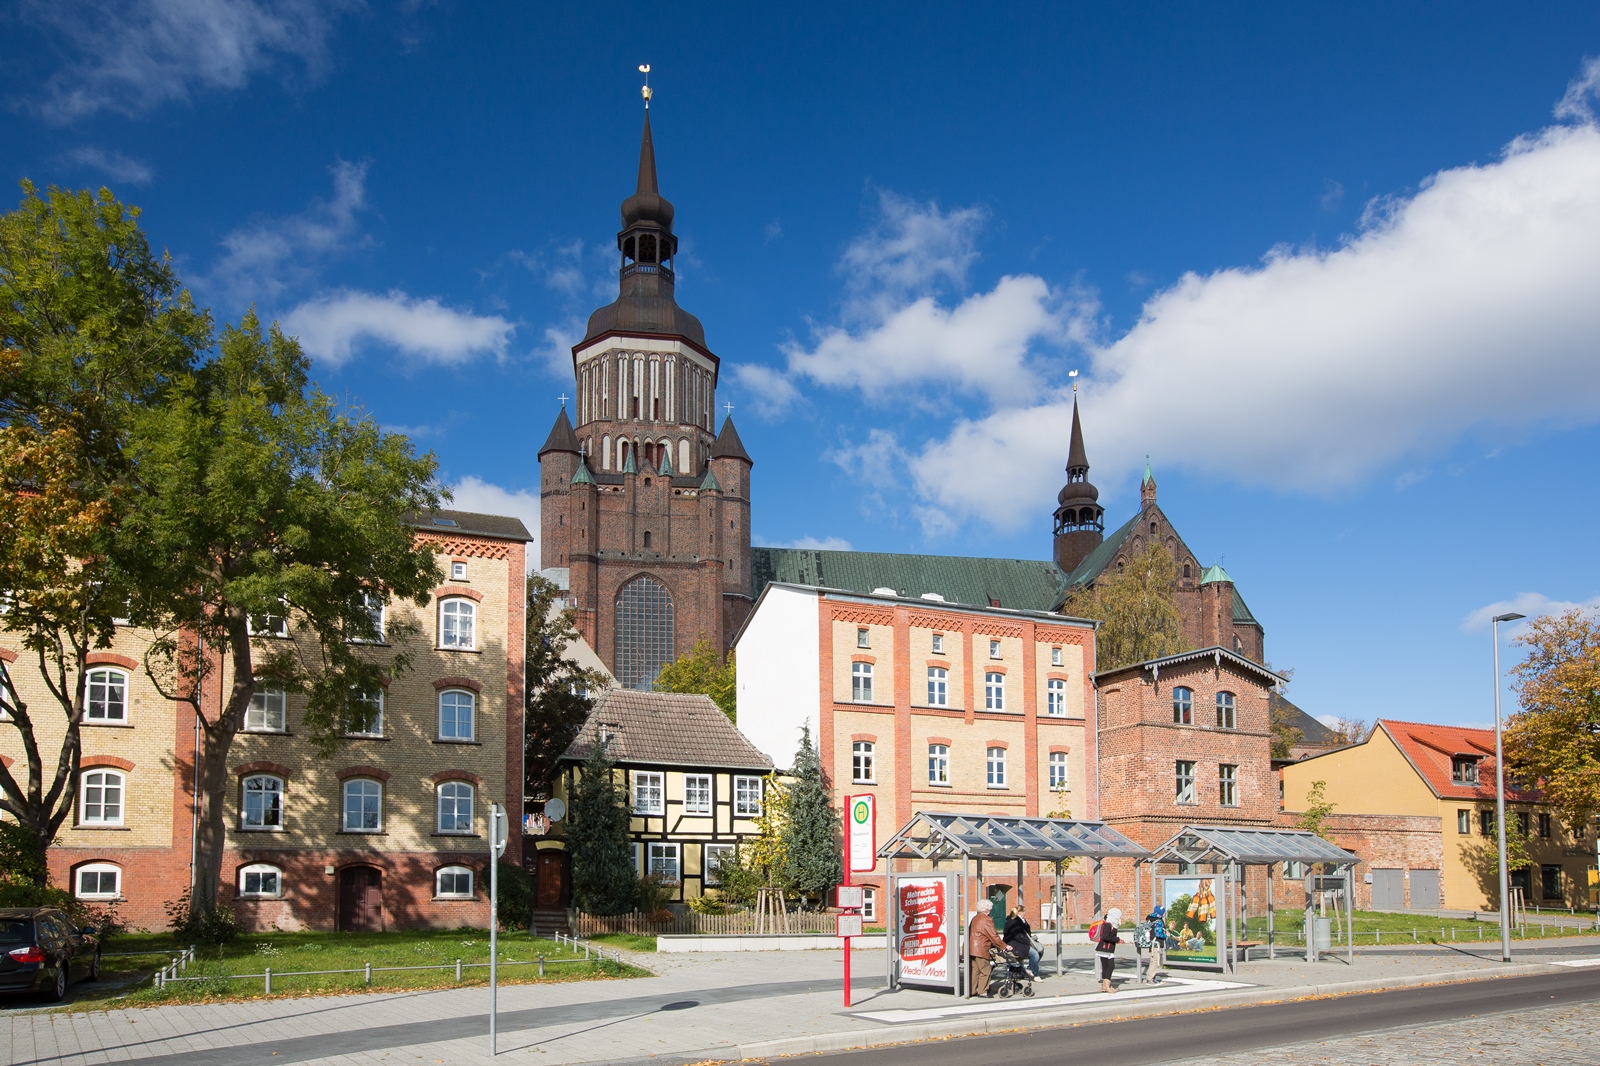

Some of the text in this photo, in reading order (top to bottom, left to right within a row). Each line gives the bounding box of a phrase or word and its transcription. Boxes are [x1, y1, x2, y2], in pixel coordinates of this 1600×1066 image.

[858, 806, 865, 820] H
[908, 888, 935, 898] Mehr echte
[905, 896, 938, 906] Schnäppchen
[904, 940, 920, 948] MEHR
[904, 948, 914, 957] FÜR
[914, 947, 925, 956] DEN
[901, 965, 946, 977] Media Markt
